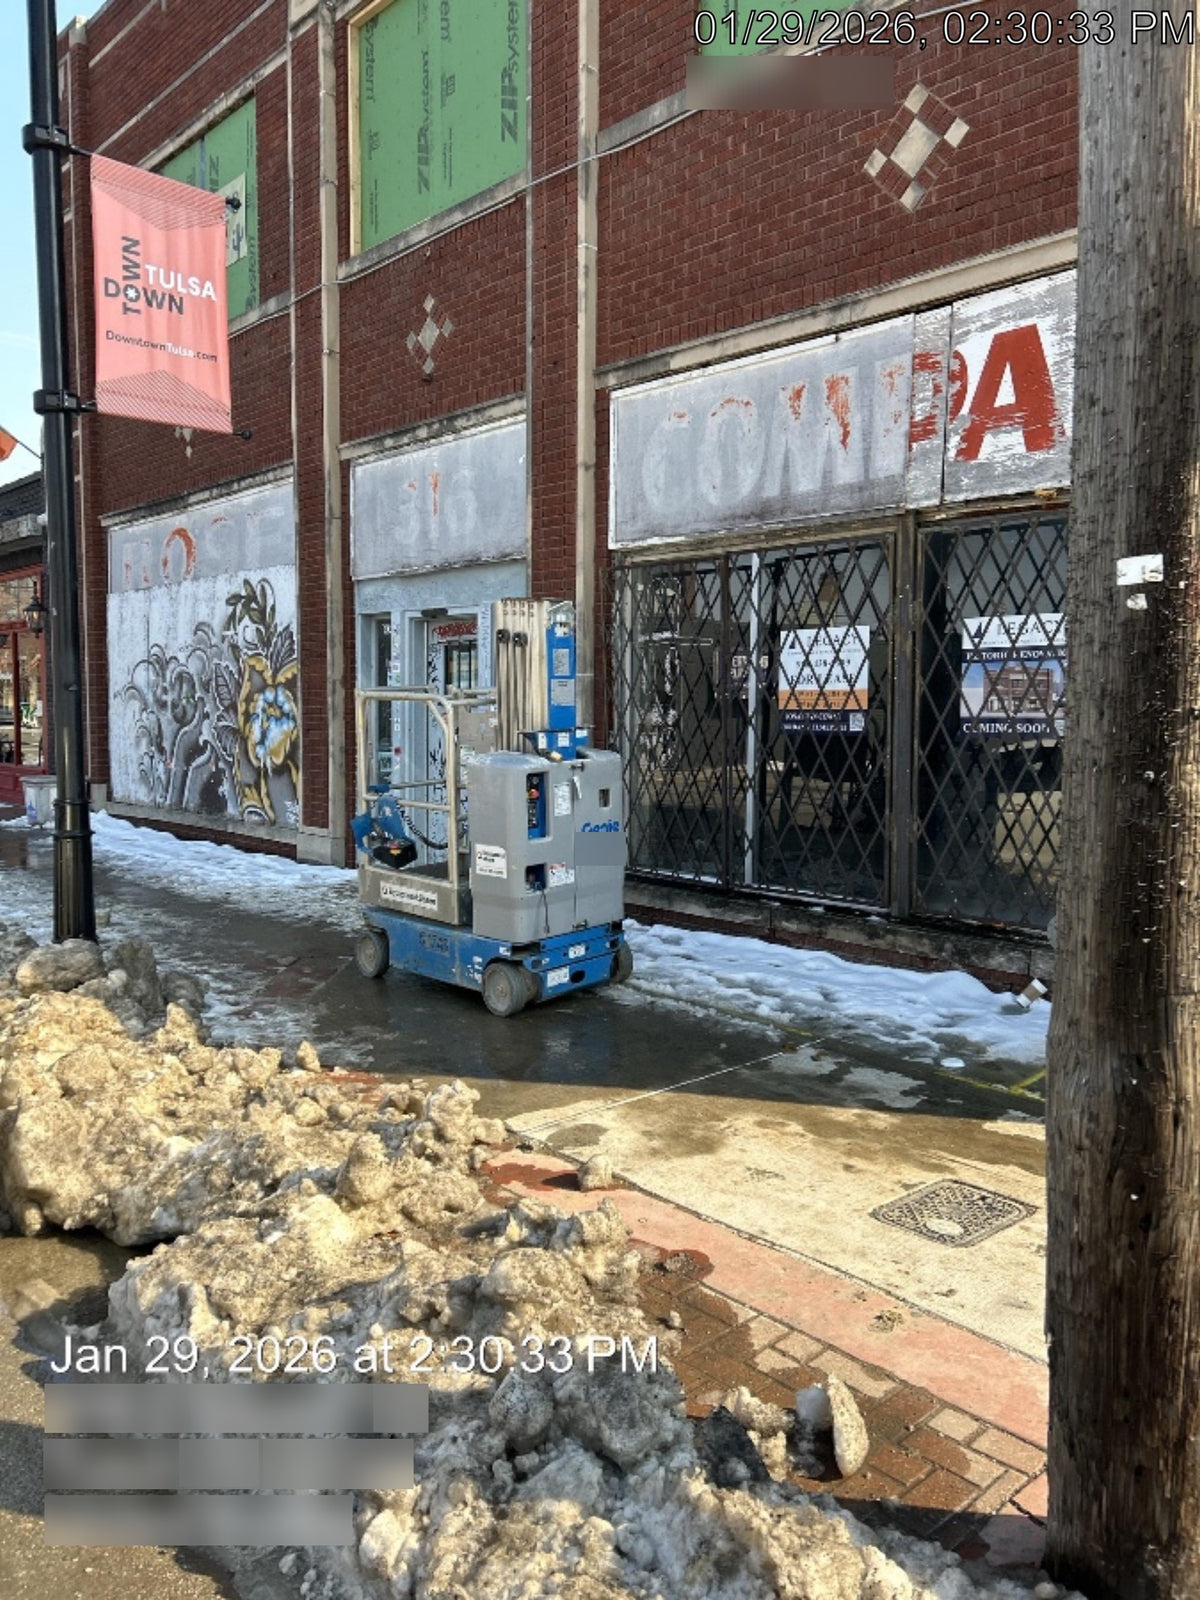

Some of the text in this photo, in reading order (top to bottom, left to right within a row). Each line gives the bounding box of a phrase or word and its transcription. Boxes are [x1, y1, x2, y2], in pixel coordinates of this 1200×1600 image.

[145, 264, 217, 302] TULSA
[106, 330, 218, 362] DowntownTulsa.com
[963, 722, 1012, 734] CMING
